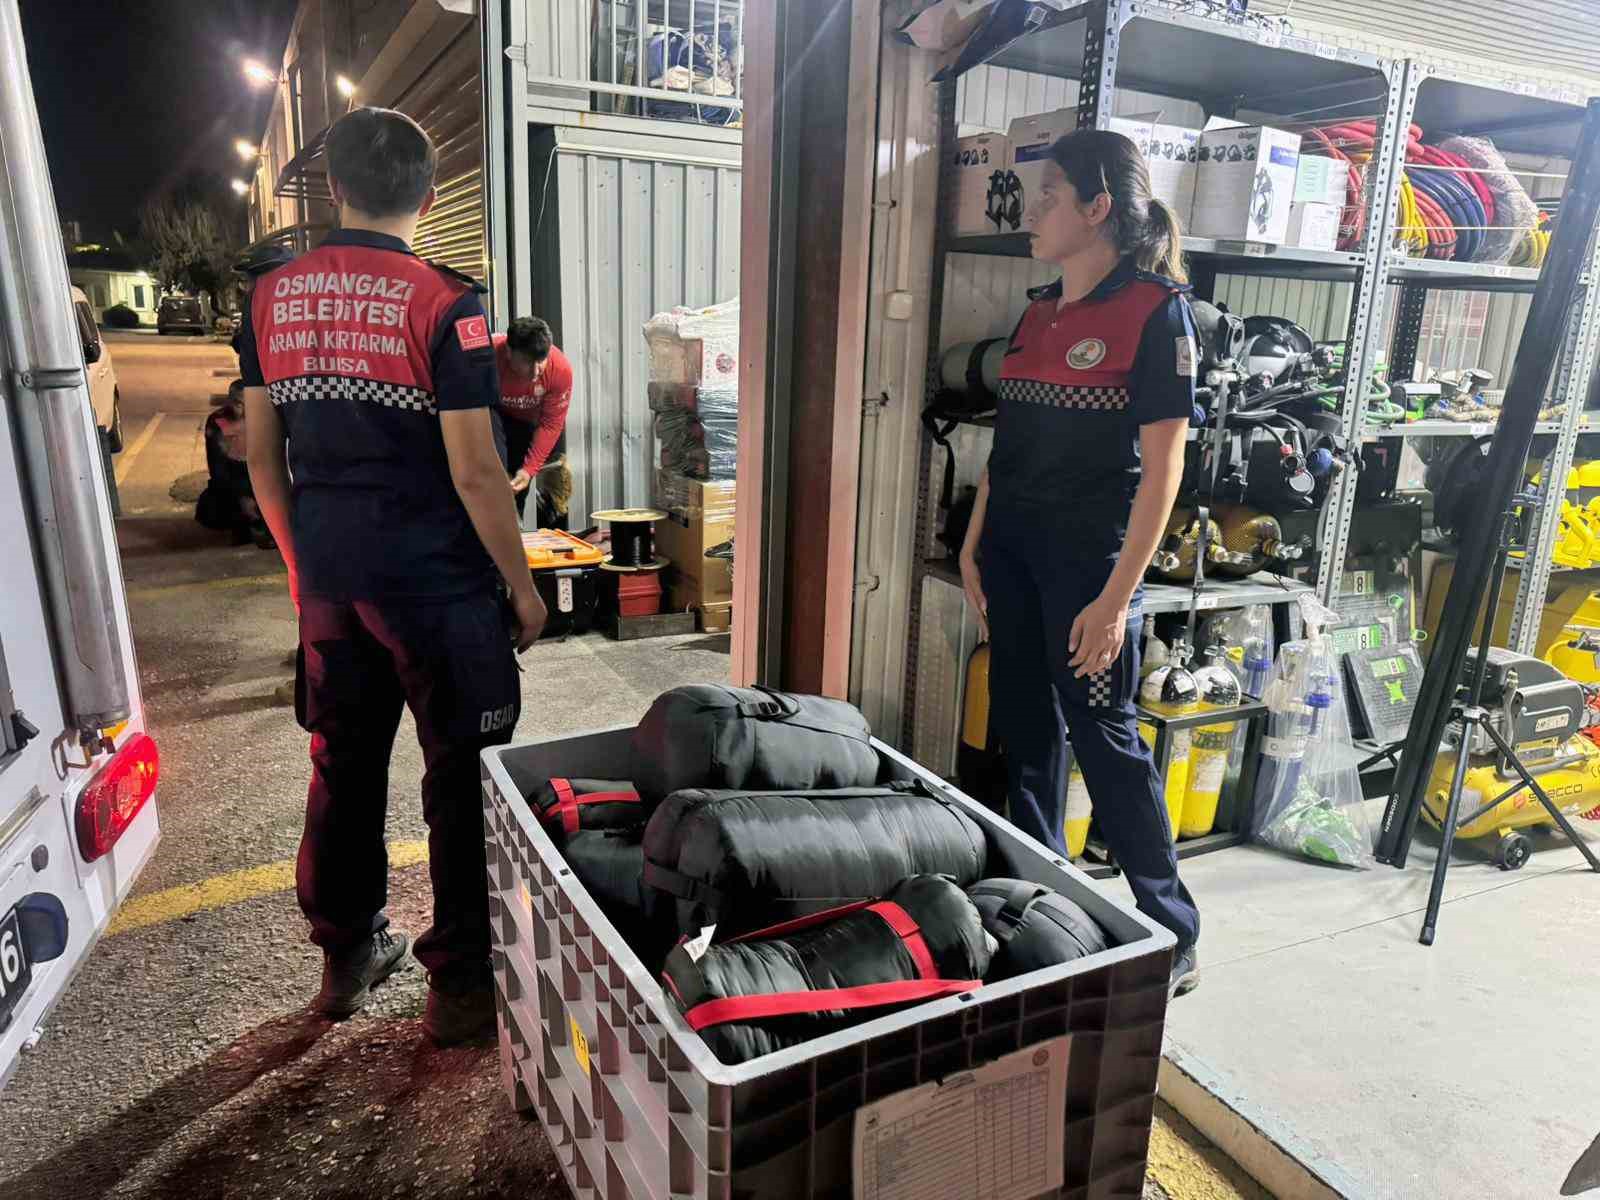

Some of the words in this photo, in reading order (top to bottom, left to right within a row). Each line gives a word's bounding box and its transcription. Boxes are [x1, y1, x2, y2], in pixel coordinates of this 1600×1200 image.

[274, 272, 414, 301] OSMANGAZİ
[273, 298, 405, 329] BELEDİYESİ
[268, 328, 318, 354] ARAMA
[324, 327, 408, 357] KRTARMA
[303, 355, 370, 374] BUSA
